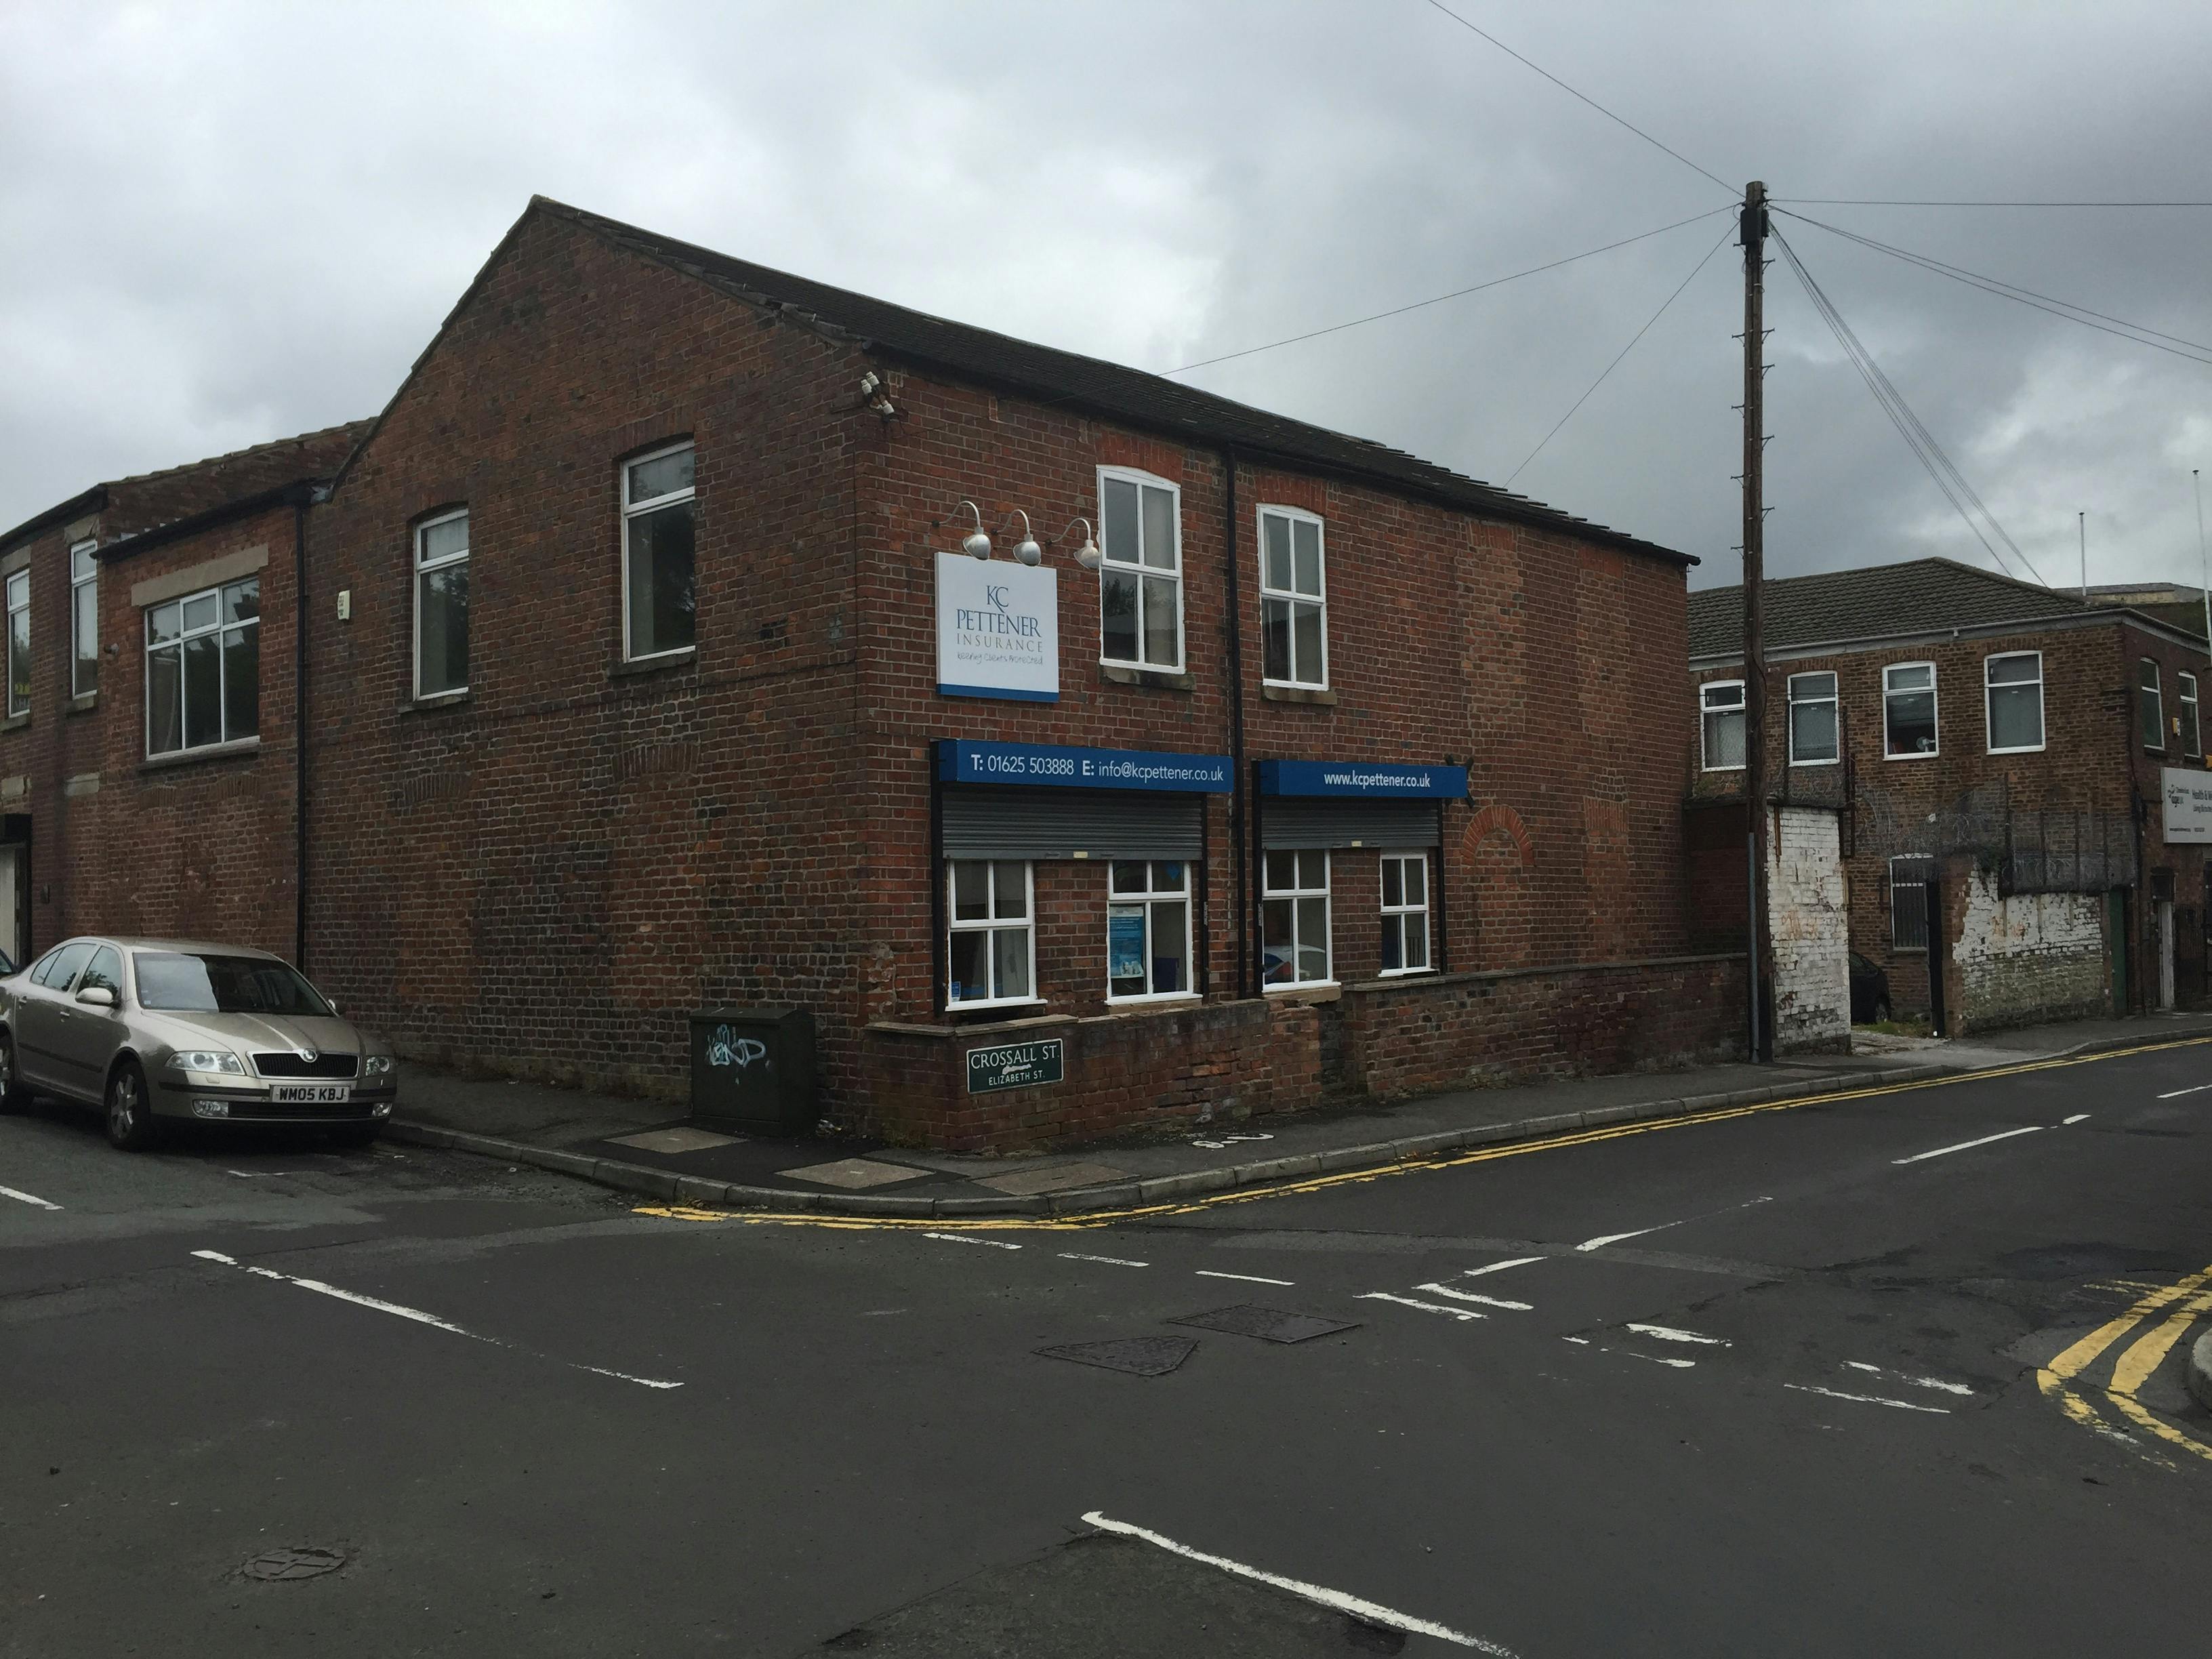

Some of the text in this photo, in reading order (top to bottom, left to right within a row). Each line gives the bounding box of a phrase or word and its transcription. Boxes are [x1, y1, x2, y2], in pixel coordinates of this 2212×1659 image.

[986, 585, 1009, 613] KC
[956, 609, 1042, 638] PETTENER
[957, 633, 1043, 653] INSURANCE
[970, 754, 1223, 783] T: 01625 503888 E: info@kcpettener.co.uk
[1324, 770, 1431, 790] www.kcpettener.co.uk
[970, 1047, 1038, 1069] CROSSALL
[989, 1072, 1030, 1086] ELIZABETH
[319, 1088, 344, 1101] KBJ
